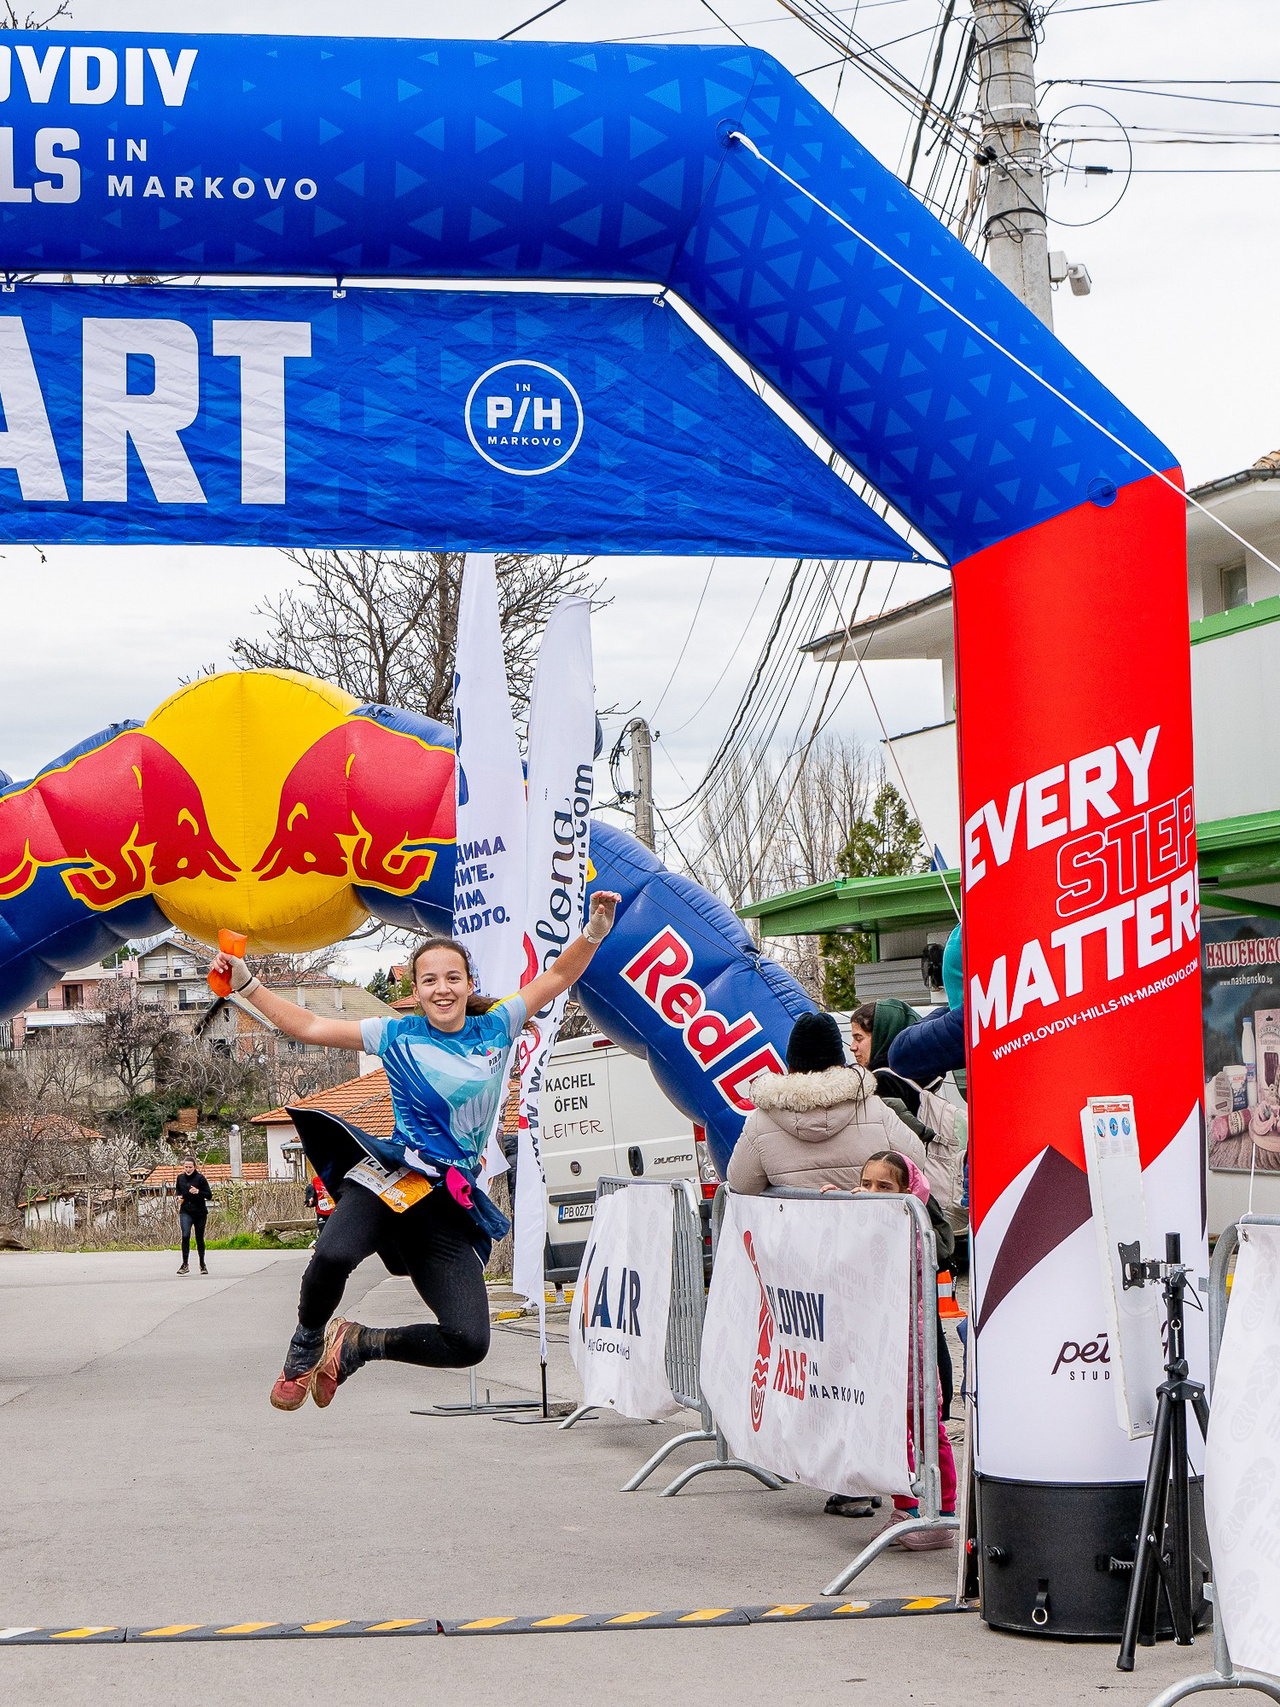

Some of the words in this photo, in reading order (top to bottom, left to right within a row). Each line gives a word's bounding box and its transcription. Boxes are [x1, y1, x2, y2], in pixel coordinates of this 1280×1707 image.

[107, 138, 148, 162] IN
[107, 176, 318, 200] MARKOVO
[515, 382, 531, 392] IN
[486, 396, 561, 433] P/H
[487, 436, 562, 447] MARKOVO
[965, 725, 1161, 893] EVERY
[1056, 786, 1195, 917] STEP
[624, 929, 757, 1067] Red
[992, 958, 1198, 1060] WWW.PLOVDIV-HILLS-IN-MARKOVO.COM
[545, 1073, 595, 1093] KACHEL
[554, 1096, 588, 1113] ÖFEN
[543, 1119, 604, 1140] LEITER
[653, 1153, 693, 1166] DUCATO
[575, 1204, 593, 1217] 0271
[809, 1361, 819, 1377] IN
[1070, 1371, 1110, 1380] STUD
[810, 1384, 865, 1406] MARKOVO
